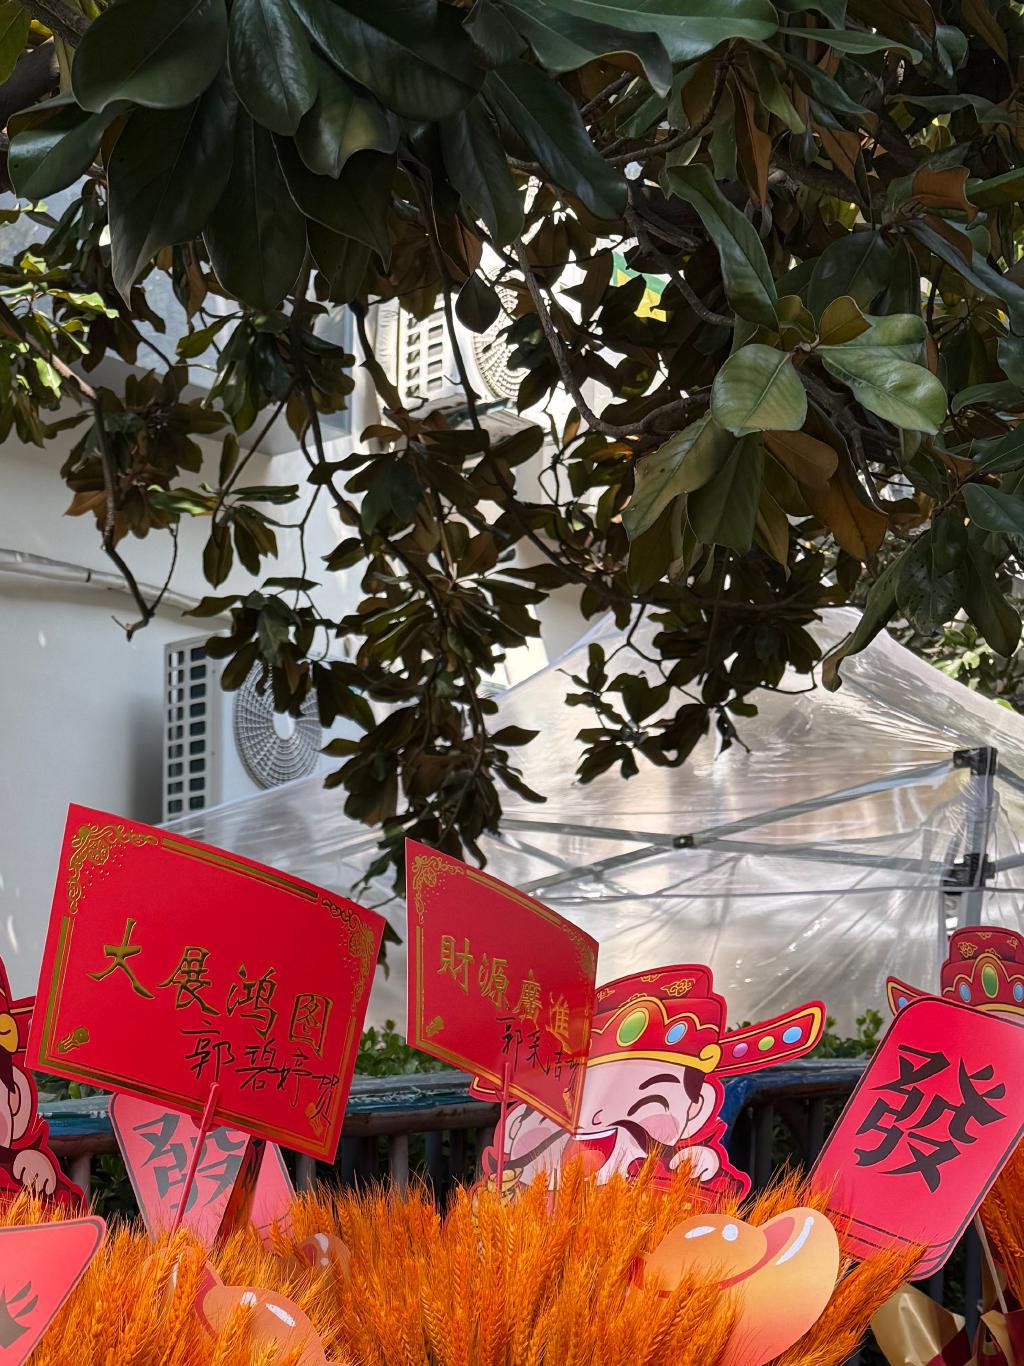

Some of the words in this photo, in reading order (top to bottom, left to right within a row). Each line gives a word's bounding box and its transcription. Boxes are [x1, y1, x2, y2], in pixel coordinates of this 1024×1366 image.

[87, 917, 333, 1056] 大展鸿图
[437, 934, 573, 1055] 財源廣進
[852, 1044, 1009, 1194] 發
